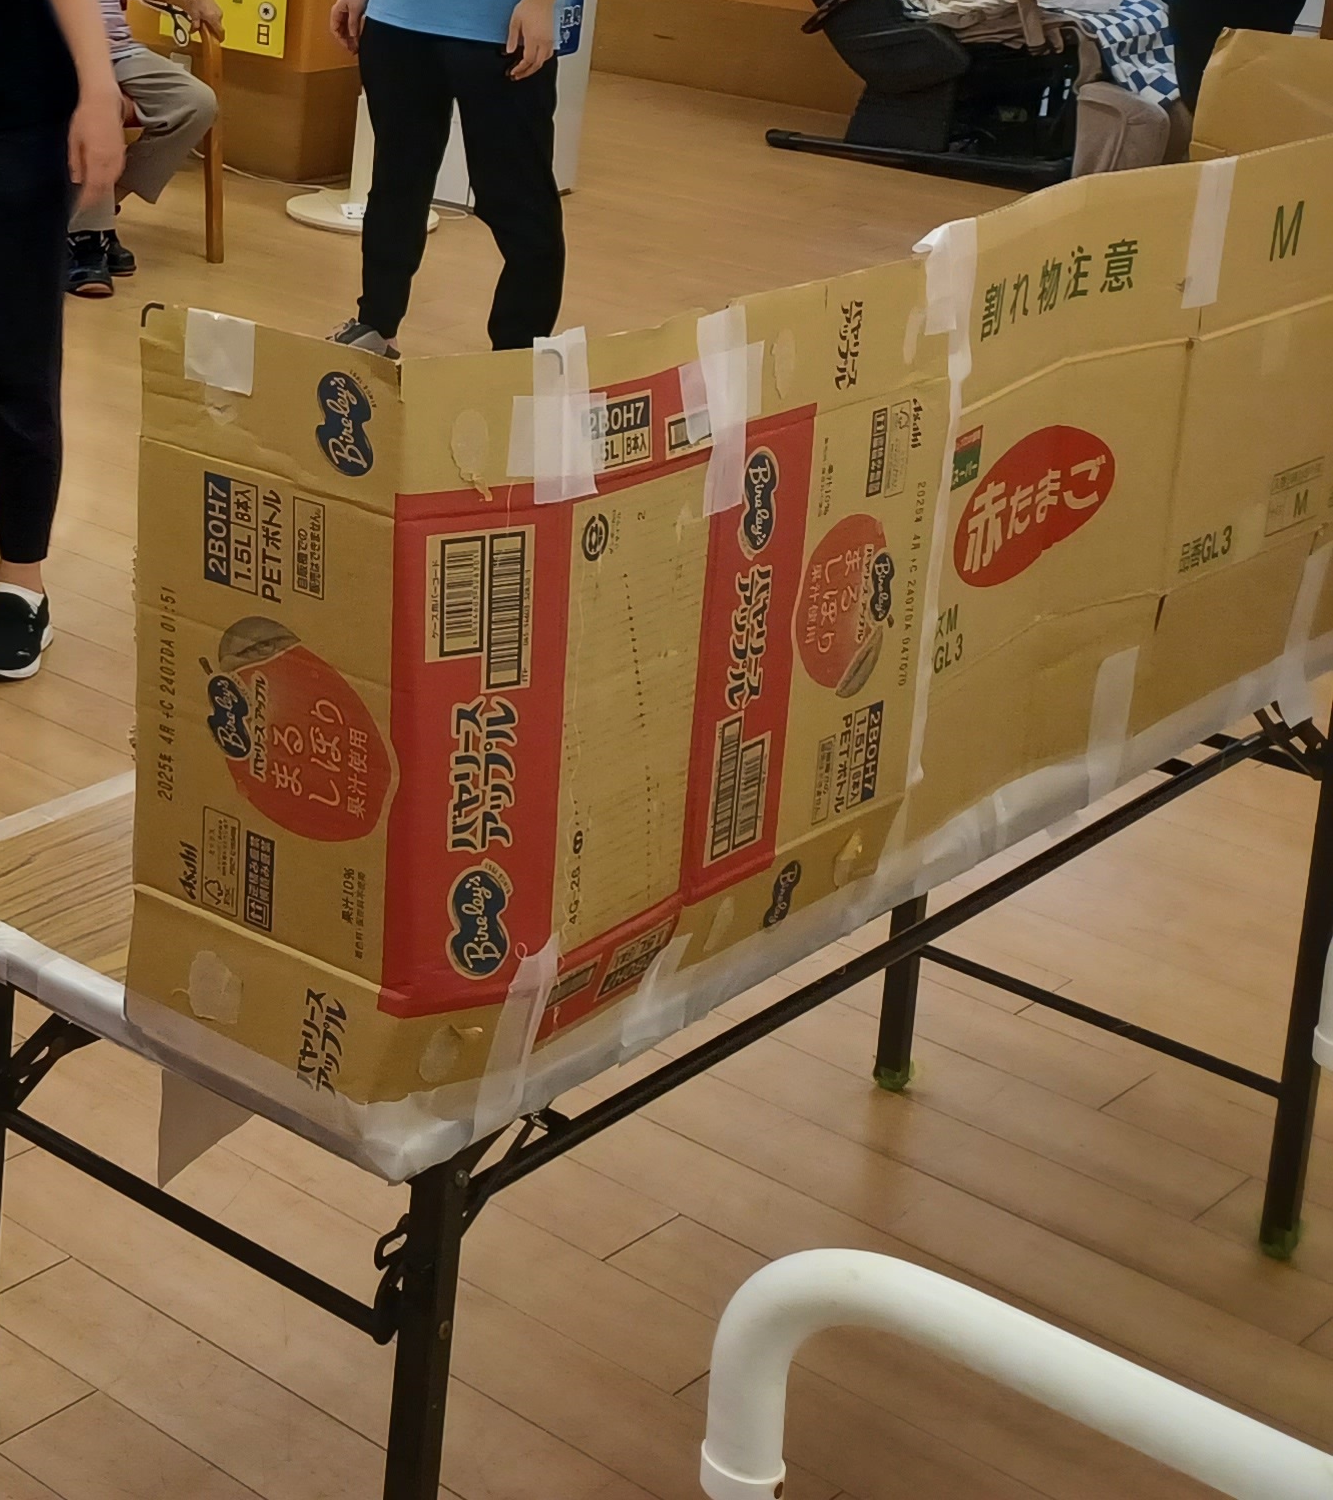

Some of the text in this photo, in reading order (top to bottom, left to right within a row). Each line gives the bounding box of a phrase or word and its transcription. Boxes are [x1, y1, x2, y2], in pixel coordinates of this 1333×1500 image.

[256, 24, 270, 45] 日
[1269, 200, 1305, 262] M
[979, 238, 1140, 343] 割れ物注意
[834, 301, 852, 390] アップル
[848, 300, 863, 388] バヤリース
[326, 376, 368, 468] Bireley's
[911, 398, 923, 449] Asahi
[234, 488, 252, 582] 1.5L 8本入
[261, 489, 283, 604] PETボトル
[962, 453, 1107, 573] 赤たまご
[1293, 489, 1309, 518] M
[818, 554, 843, 654] しぼり
[841, 548, 863, 612] まる
[726, 569, 751, 708] アップル
[746, 568, 771, 703] バヤリース
[215, 678, 247, 751] Bireley's
[270, 723, 304, 797] まる
[309, 697, 345, 807] しぼり
[853, 716, 867, 765] 1.5L
[347, 727, 368, 820] 果汁使用
[451, 699, 485, 851] バヤリース
[481, 700, 518, 848] アップル
[834, 713, 852, 814] PETボトル
[178, 840, 199, 900] Asahi
[341, 867, 355, 925] 果汁10%
[461, 875, 501, 968] Bireley's
[296, 987, 327, 1089] バヤリース
[315, 995, 347, 1096] アップル
